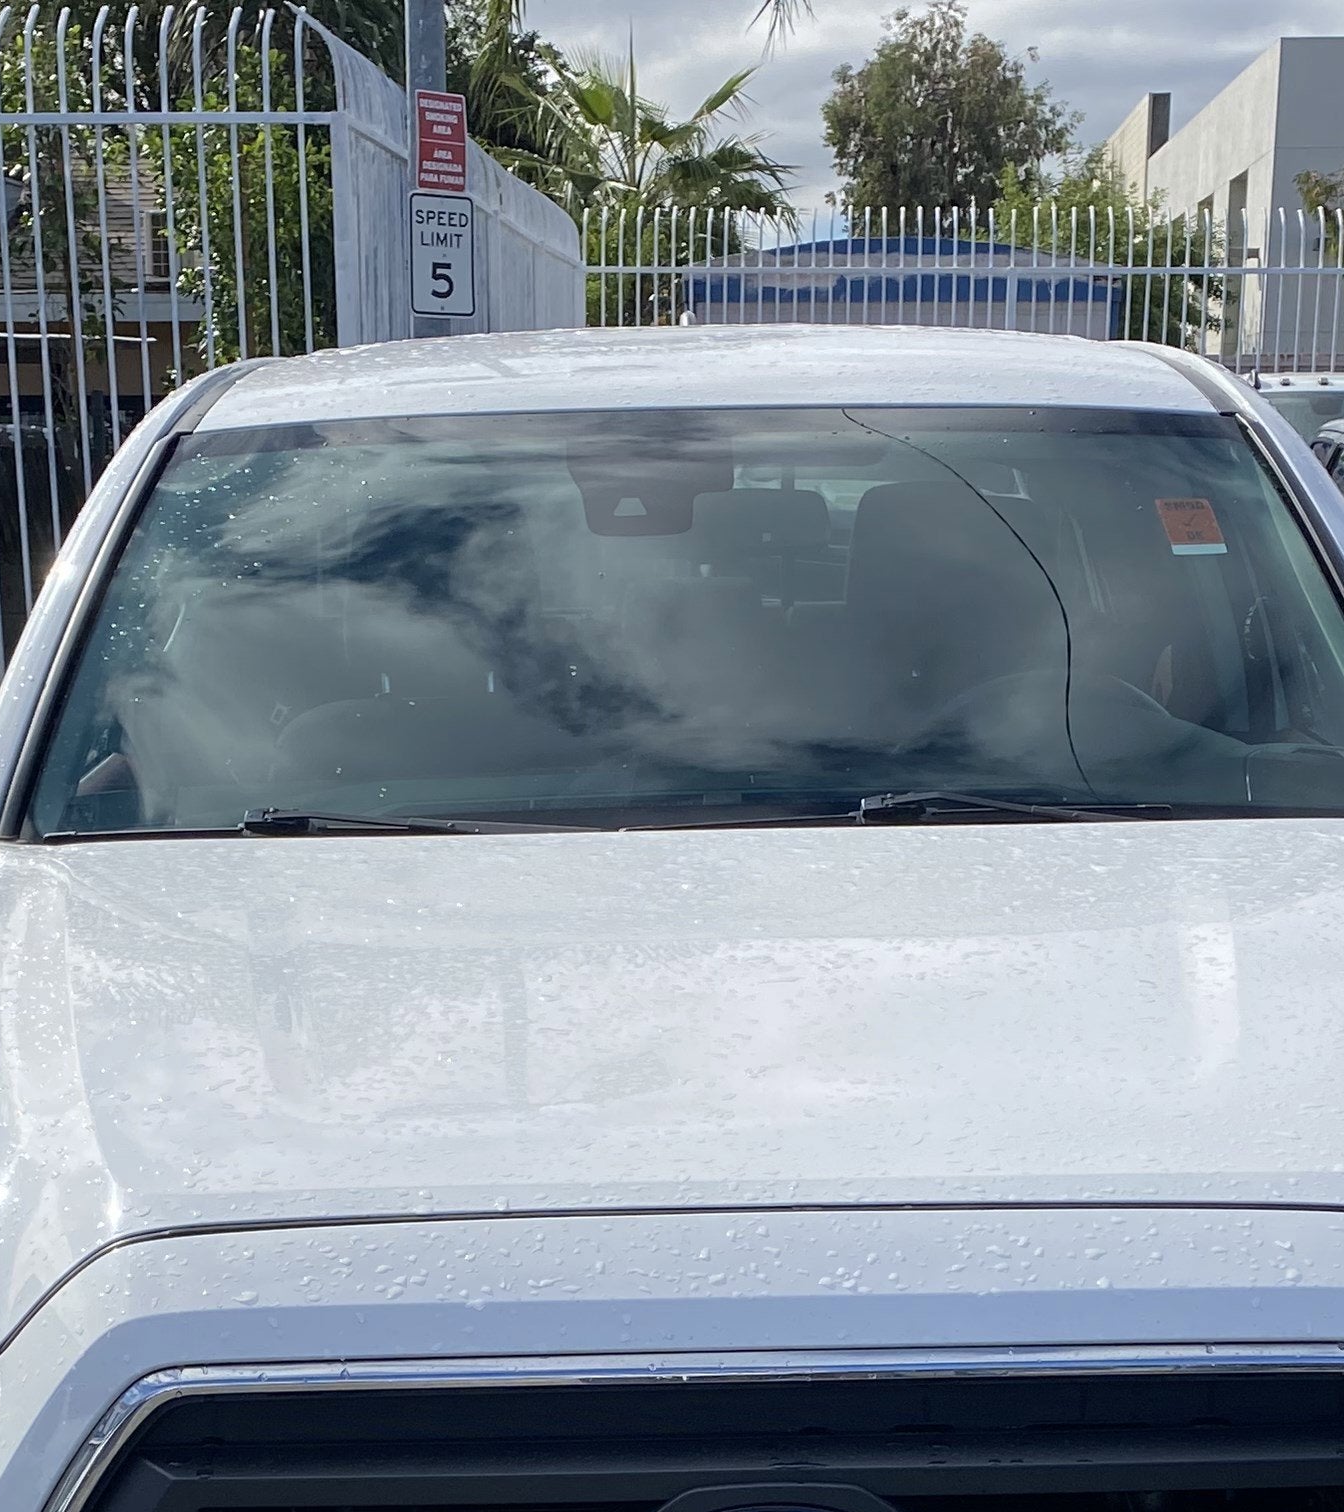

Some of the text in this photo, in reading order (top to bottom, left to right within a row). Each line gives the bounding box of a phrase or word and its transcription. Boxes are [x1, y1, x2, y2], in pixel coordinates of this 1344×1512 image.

[415, 209, 469, 228] SPEED
[420, 230, 464, 249] LIMIT
[430, 261, 454, 299] 5
